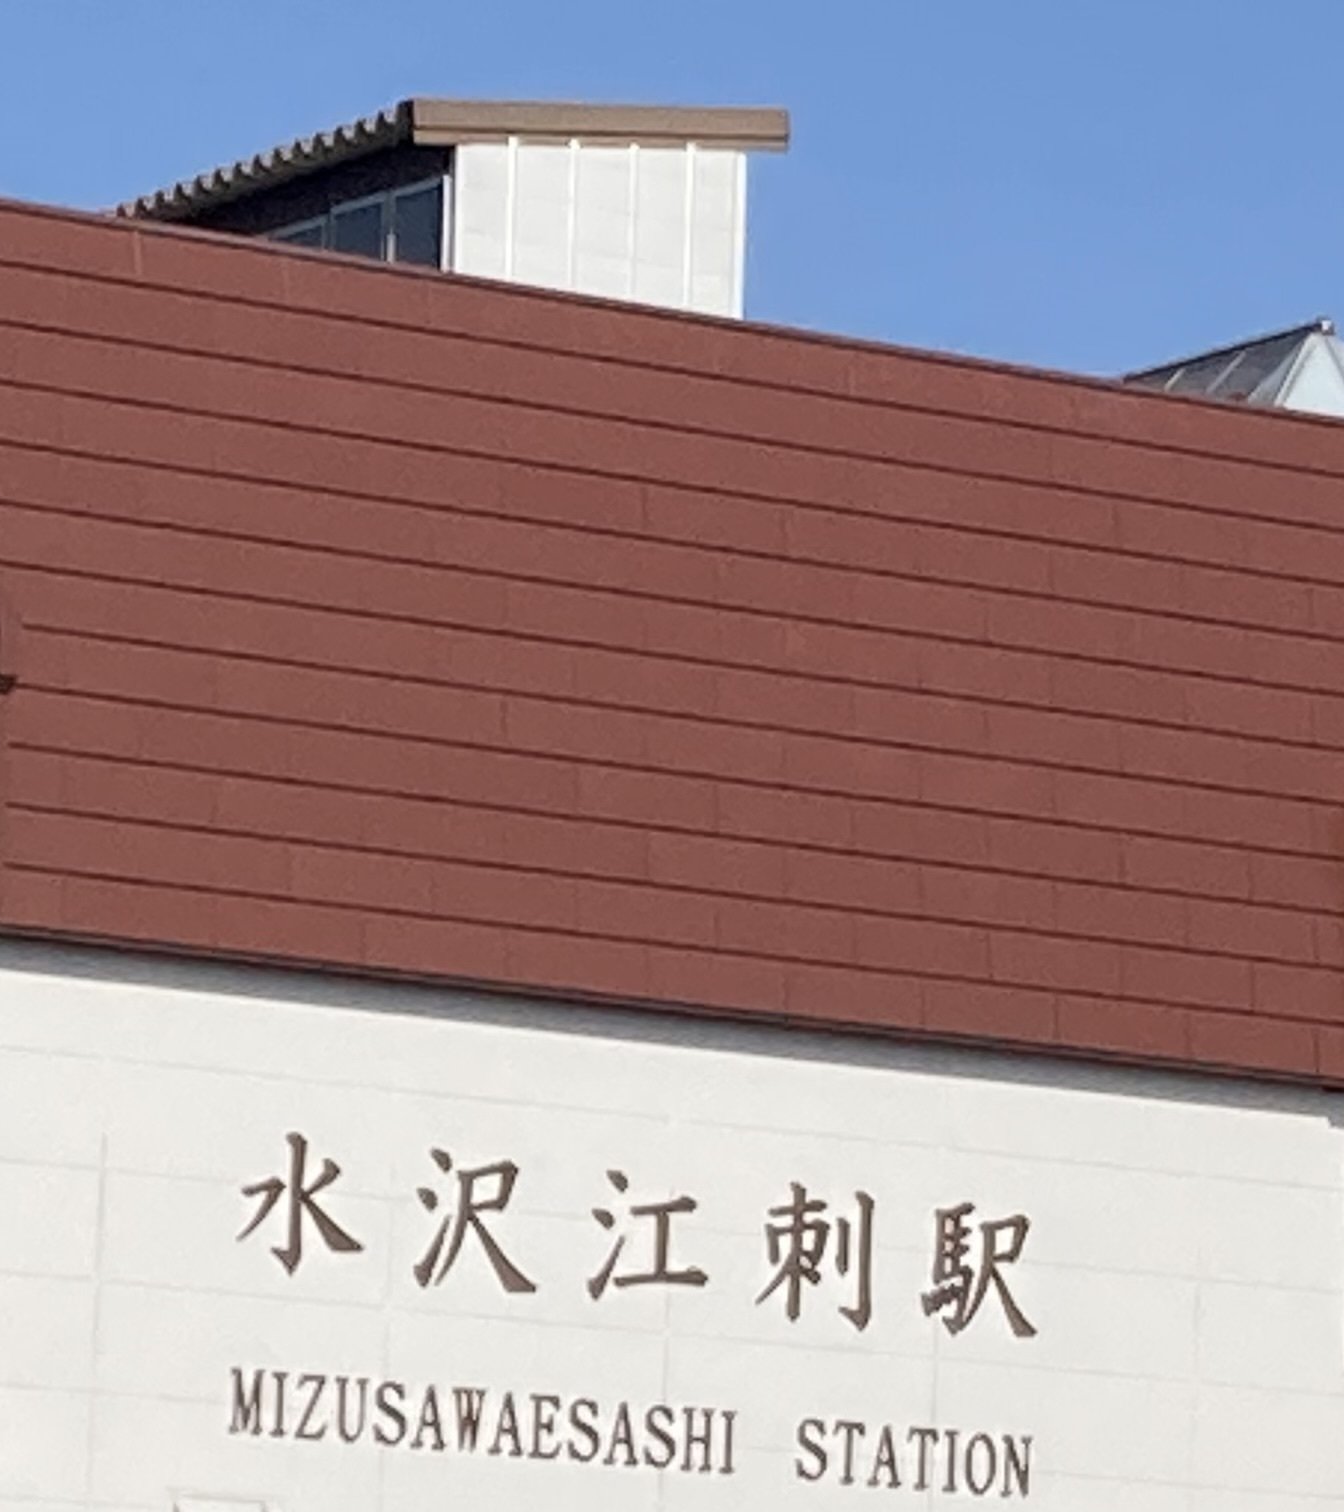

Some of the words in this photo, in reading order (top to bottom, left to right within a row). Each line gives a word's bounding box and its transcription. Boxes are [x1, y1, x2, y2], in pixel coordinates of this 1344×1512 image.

[236, 1131, 1039, 1339] 水沢江刺駅
[228, 1366, 738, 1476] MIZUSAWAESASHI
[794, 1419, 1035, 1500] STATION
